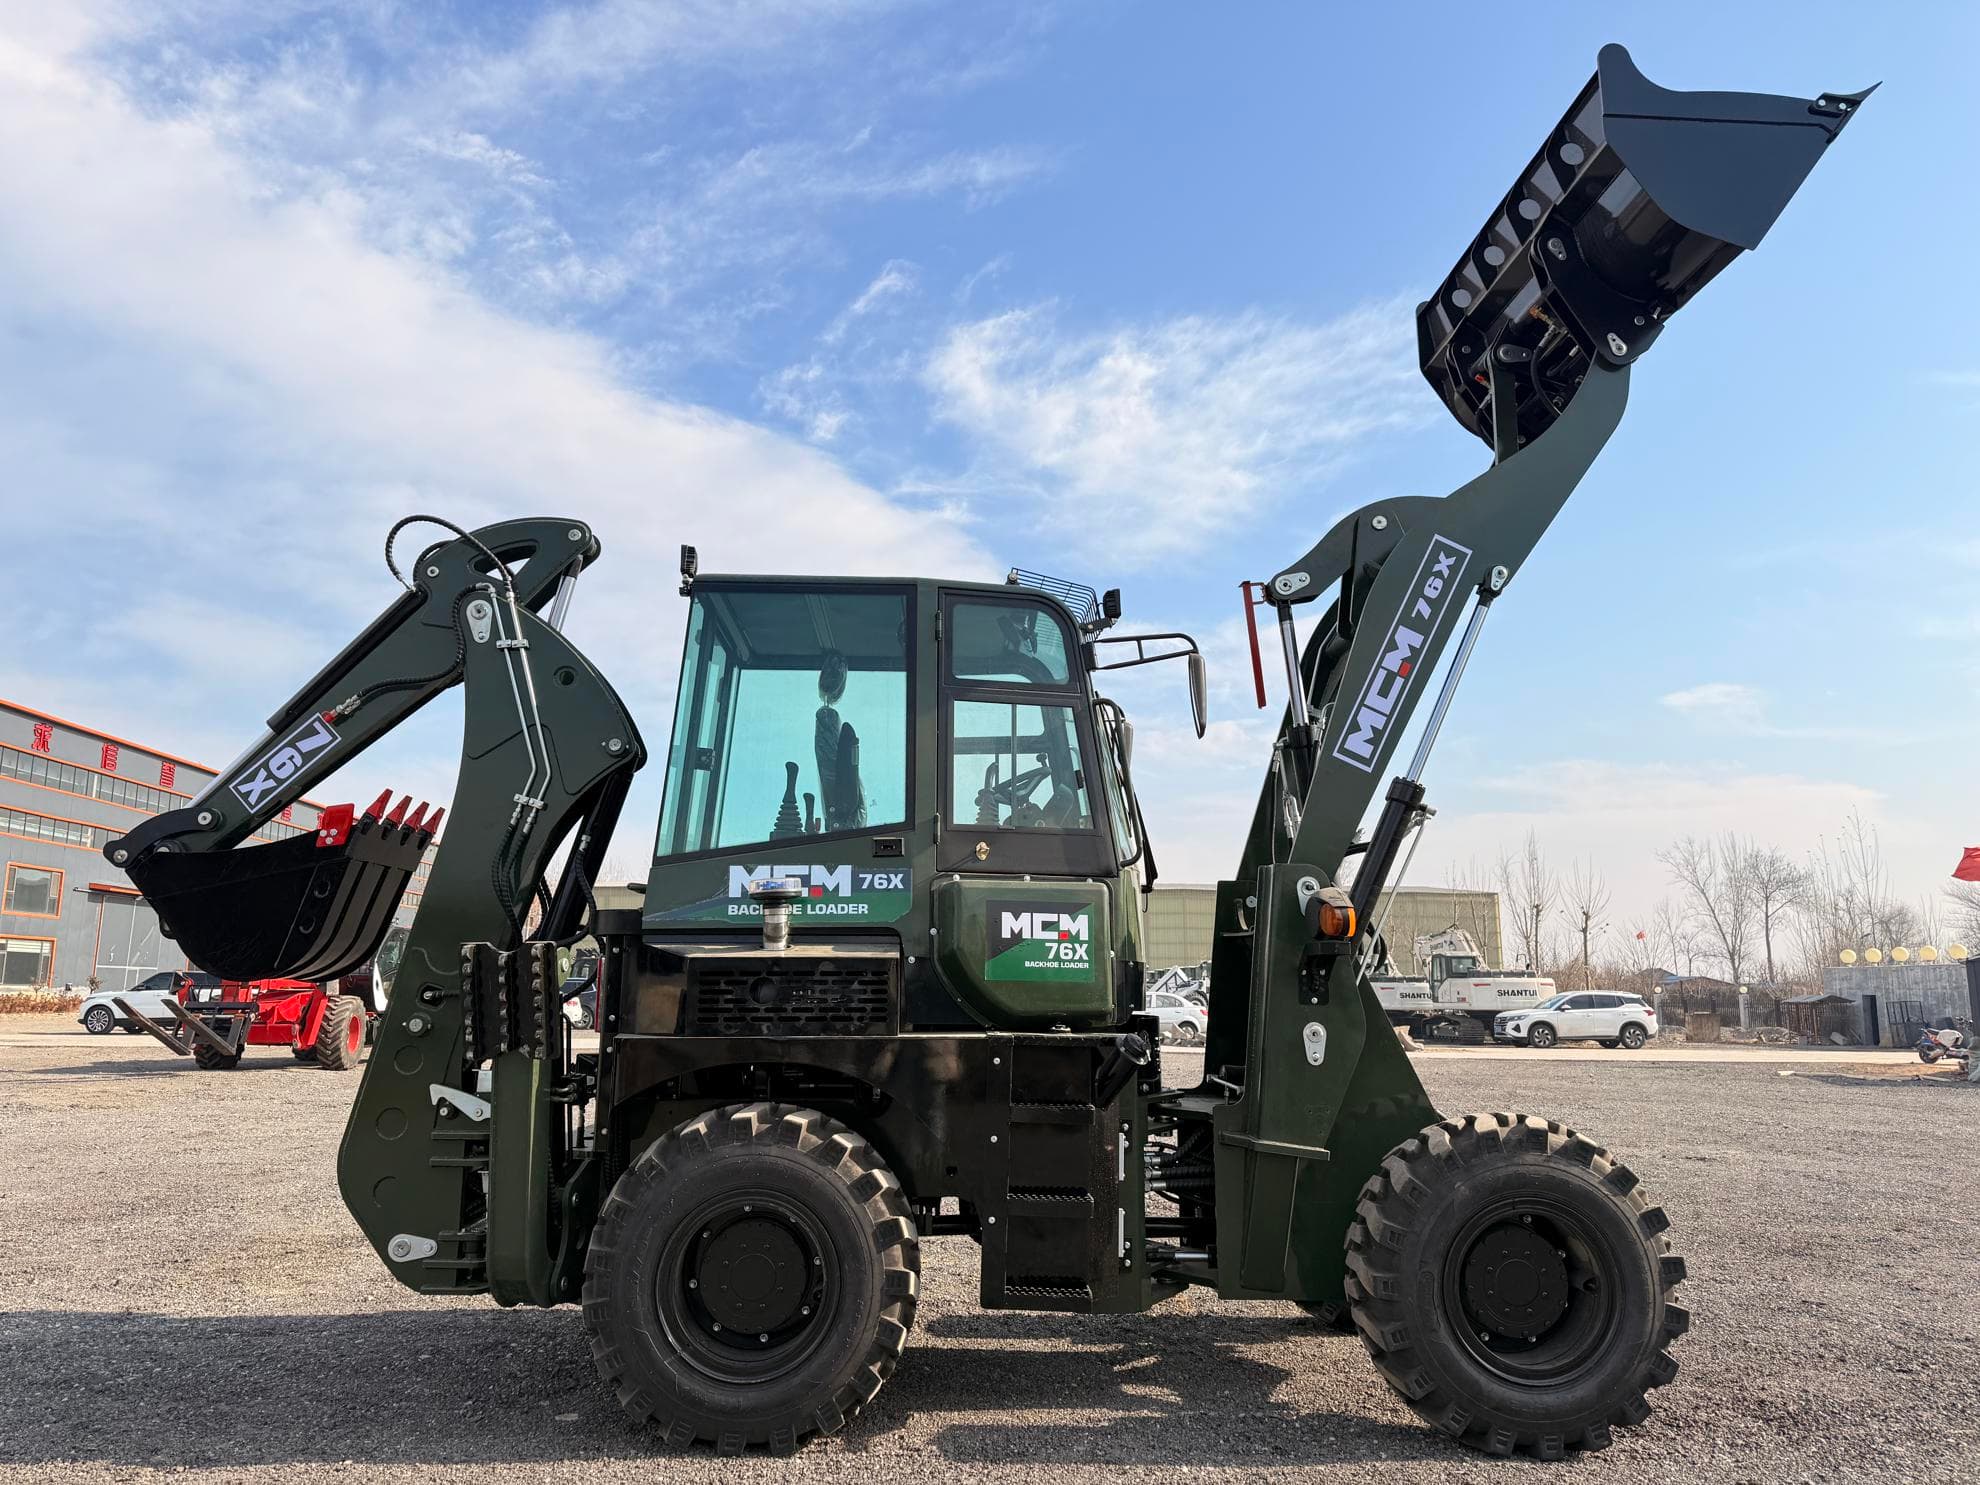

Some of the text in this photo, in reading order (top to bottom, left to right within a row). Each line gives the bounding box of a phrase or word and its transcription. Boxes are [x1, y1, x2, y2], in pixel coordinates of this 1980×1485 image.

[1344, 551, 1456, 758] MCM 76X
[237, 721, 332, 805] 76X
[859, 874, 904, 889] 76X
[807, 904, 868, 914] LOADER
[1002, 912, 1088, 940] MCM
[1045, 943, 1088, 960] 76X
